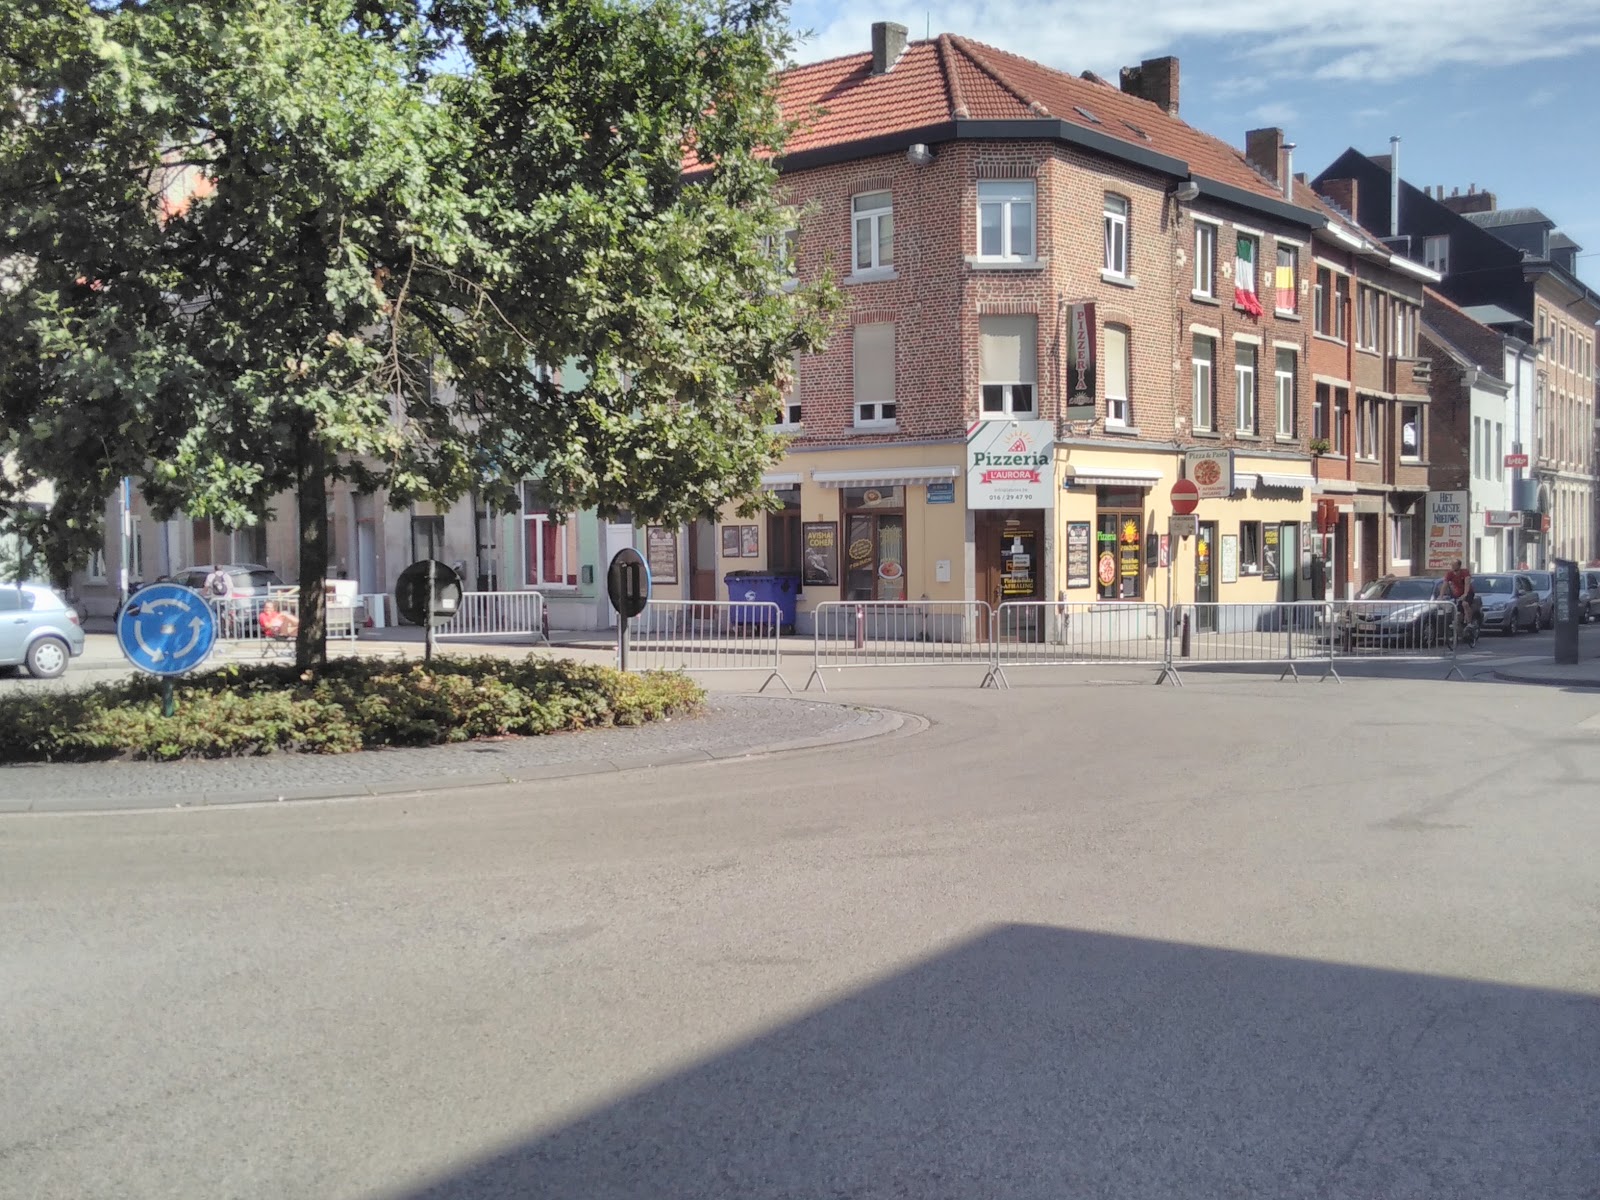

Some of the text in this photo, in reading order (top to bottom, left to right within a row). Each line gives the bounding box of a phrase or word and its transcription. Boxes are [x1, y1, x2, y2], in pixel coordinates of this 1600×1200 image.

[1076, 311, 1087, 390] PIZZERIA
[973, 452, 1049, 466] Pizzeria
[1212, 451, 1228, 459] Pasta
[990, 470, 1031, 479] L'AURORA
[1440, 493, 1453, 502] HET
[1433, 503, 1460, 513] LAATSTE
[1433, 513, 1459, 523] NIEUWS
[809, 539, 834, 547] COHEN
